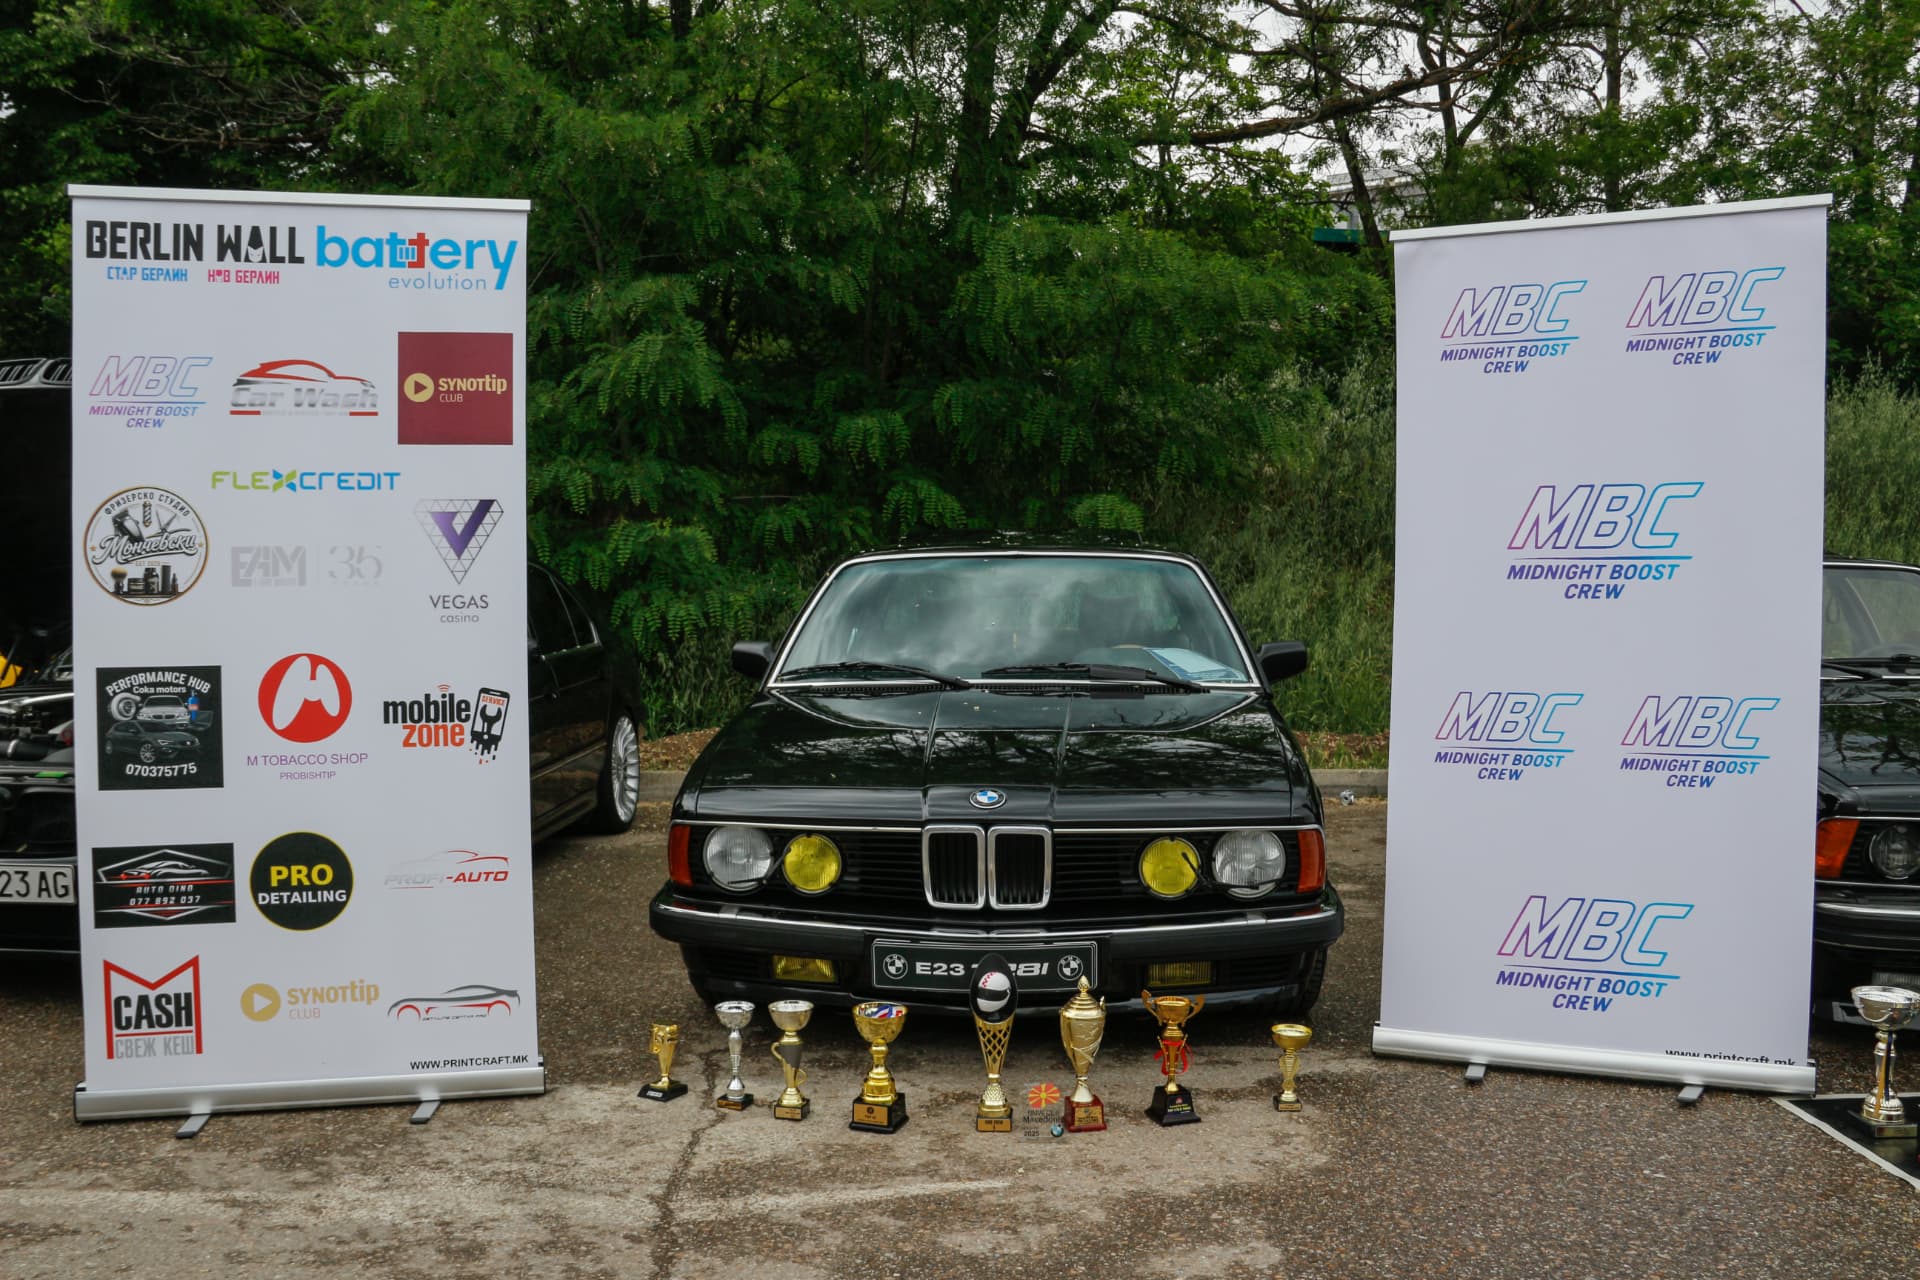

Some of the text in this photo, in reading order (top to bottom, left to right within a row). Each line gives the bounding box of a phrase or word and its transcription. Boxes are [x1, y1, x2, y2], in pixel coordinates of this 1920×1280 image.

[86, 220, 305, 264] BERLIN WALL
[316, 225, 518, 290] battery
[388, 272, 487, 290] evolution
[1625, 266, 1786, 328] MBC
[1440, 280, 1588, 338] MBC
[1625, 332, 1767, 352] MIDNIGHT BOOST
[1440, 343, 1570, 362] MIDNIGHT BOOST
[1672, 350, 1722, 365] CREW
[1483, 360, 1530, 373] CREW
[88, 355, 213, 397] MBC
[440, 393, 463, 402] CLUB
[89, 405, 199, 416] MIDNIGHT BOOST
[126, 418, 165, 428] CREW
[1506, 481, 1705, 550] MBC
[1507, 564, 1681, 580] MIDNIGHT BOOST
[1564, 583, 1626, 600] CREW
[429, 594, 489, 609] VEGAS
[440, 614, 480, 623] casino
[105, 671, 211, 696] PERFORMANCE HUB
[132, 686, 187, 694] Coka motors
[383, 693, 471, 724] mobile
[1434, 691, 1585, 744] MBC
[1620, 695, 1781, 750] MBC
[402, 723, 465, 748] zone
[247, 753, 368, 766] M TOBACCO SHOP
[1434, 751, 1565, 768] MIDNIGHT BOOST
[1620, 757, 1760, 774] MIDNIGHT BOOST
[125, 762, 197, 777] 070375775
[279, 771, 336, 780] PROBISHTIP
[1477, 767, 1524, 781] CREW
[1666, 774, 1716, 788] CREW
[270, 864, 334, 887] PRO
[37, 871, 70, 898] AG
[257, 890, 347, 905] DETAILING
[1496, 895, 1695, 967] MBC
[915, 962, 965, 976] E23
[1496, 970, 1668, 997] MIDNIGHT BOOST
[1552, 993, 1614, 1012] CREW
[113, 992, 194, 1031] CASH
[289, 1007, 321, 1020] CLUB
[115, 1035, 194, 1059] СВЕЖ КЕШ
[410, 1055, 529, 1070] WWW.PRINTCRAFT.MK
